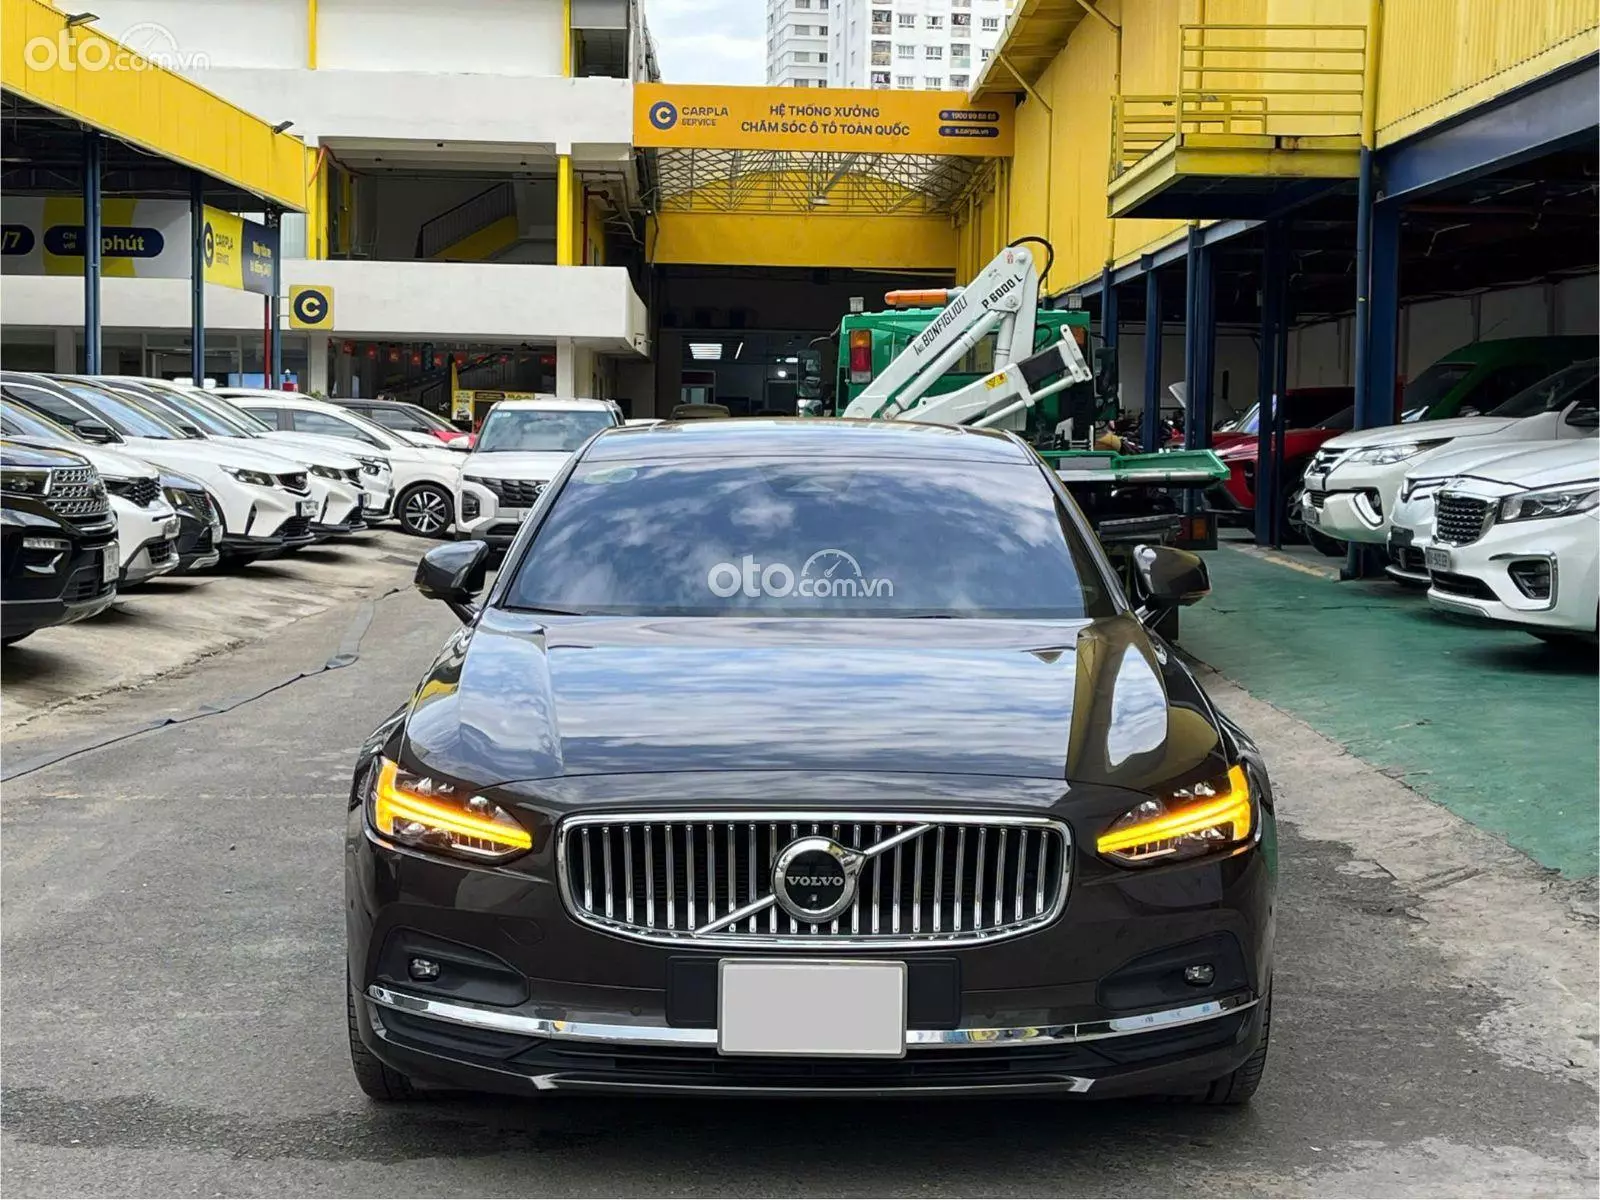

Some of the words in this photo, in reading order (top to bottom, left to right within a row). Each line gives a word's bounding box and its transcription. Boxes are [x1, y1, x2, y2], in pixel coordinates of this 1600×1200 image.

[682, 106, 728, 117] CARPLA
[769, 104, 786, 118] HỆ
[788, 103, 832, 117] THỐNG
[834, 104, 880, 118] XƯỞNG
[682, 118, 716, 126] SERVICE
[741, 119, 778, 133] CHĂM
[780, 120, 806, 133] SÓC
[809, 121, 818, 134] Ô
[821, 121, 838, 134] TÔ
[839, 121, 872, 135] TOÀN
[875, 122, 910, 136] QUỐC
[101, 234, 145, 253] phút
[981, 299, 990, 310] P
[989, 279, 1016, 303] 6000
[1014, 273, 1023, 283] L
[921, 295, 968, 348] BONFIGLIOLI
[786, 876, 844, 886] VOLVO
